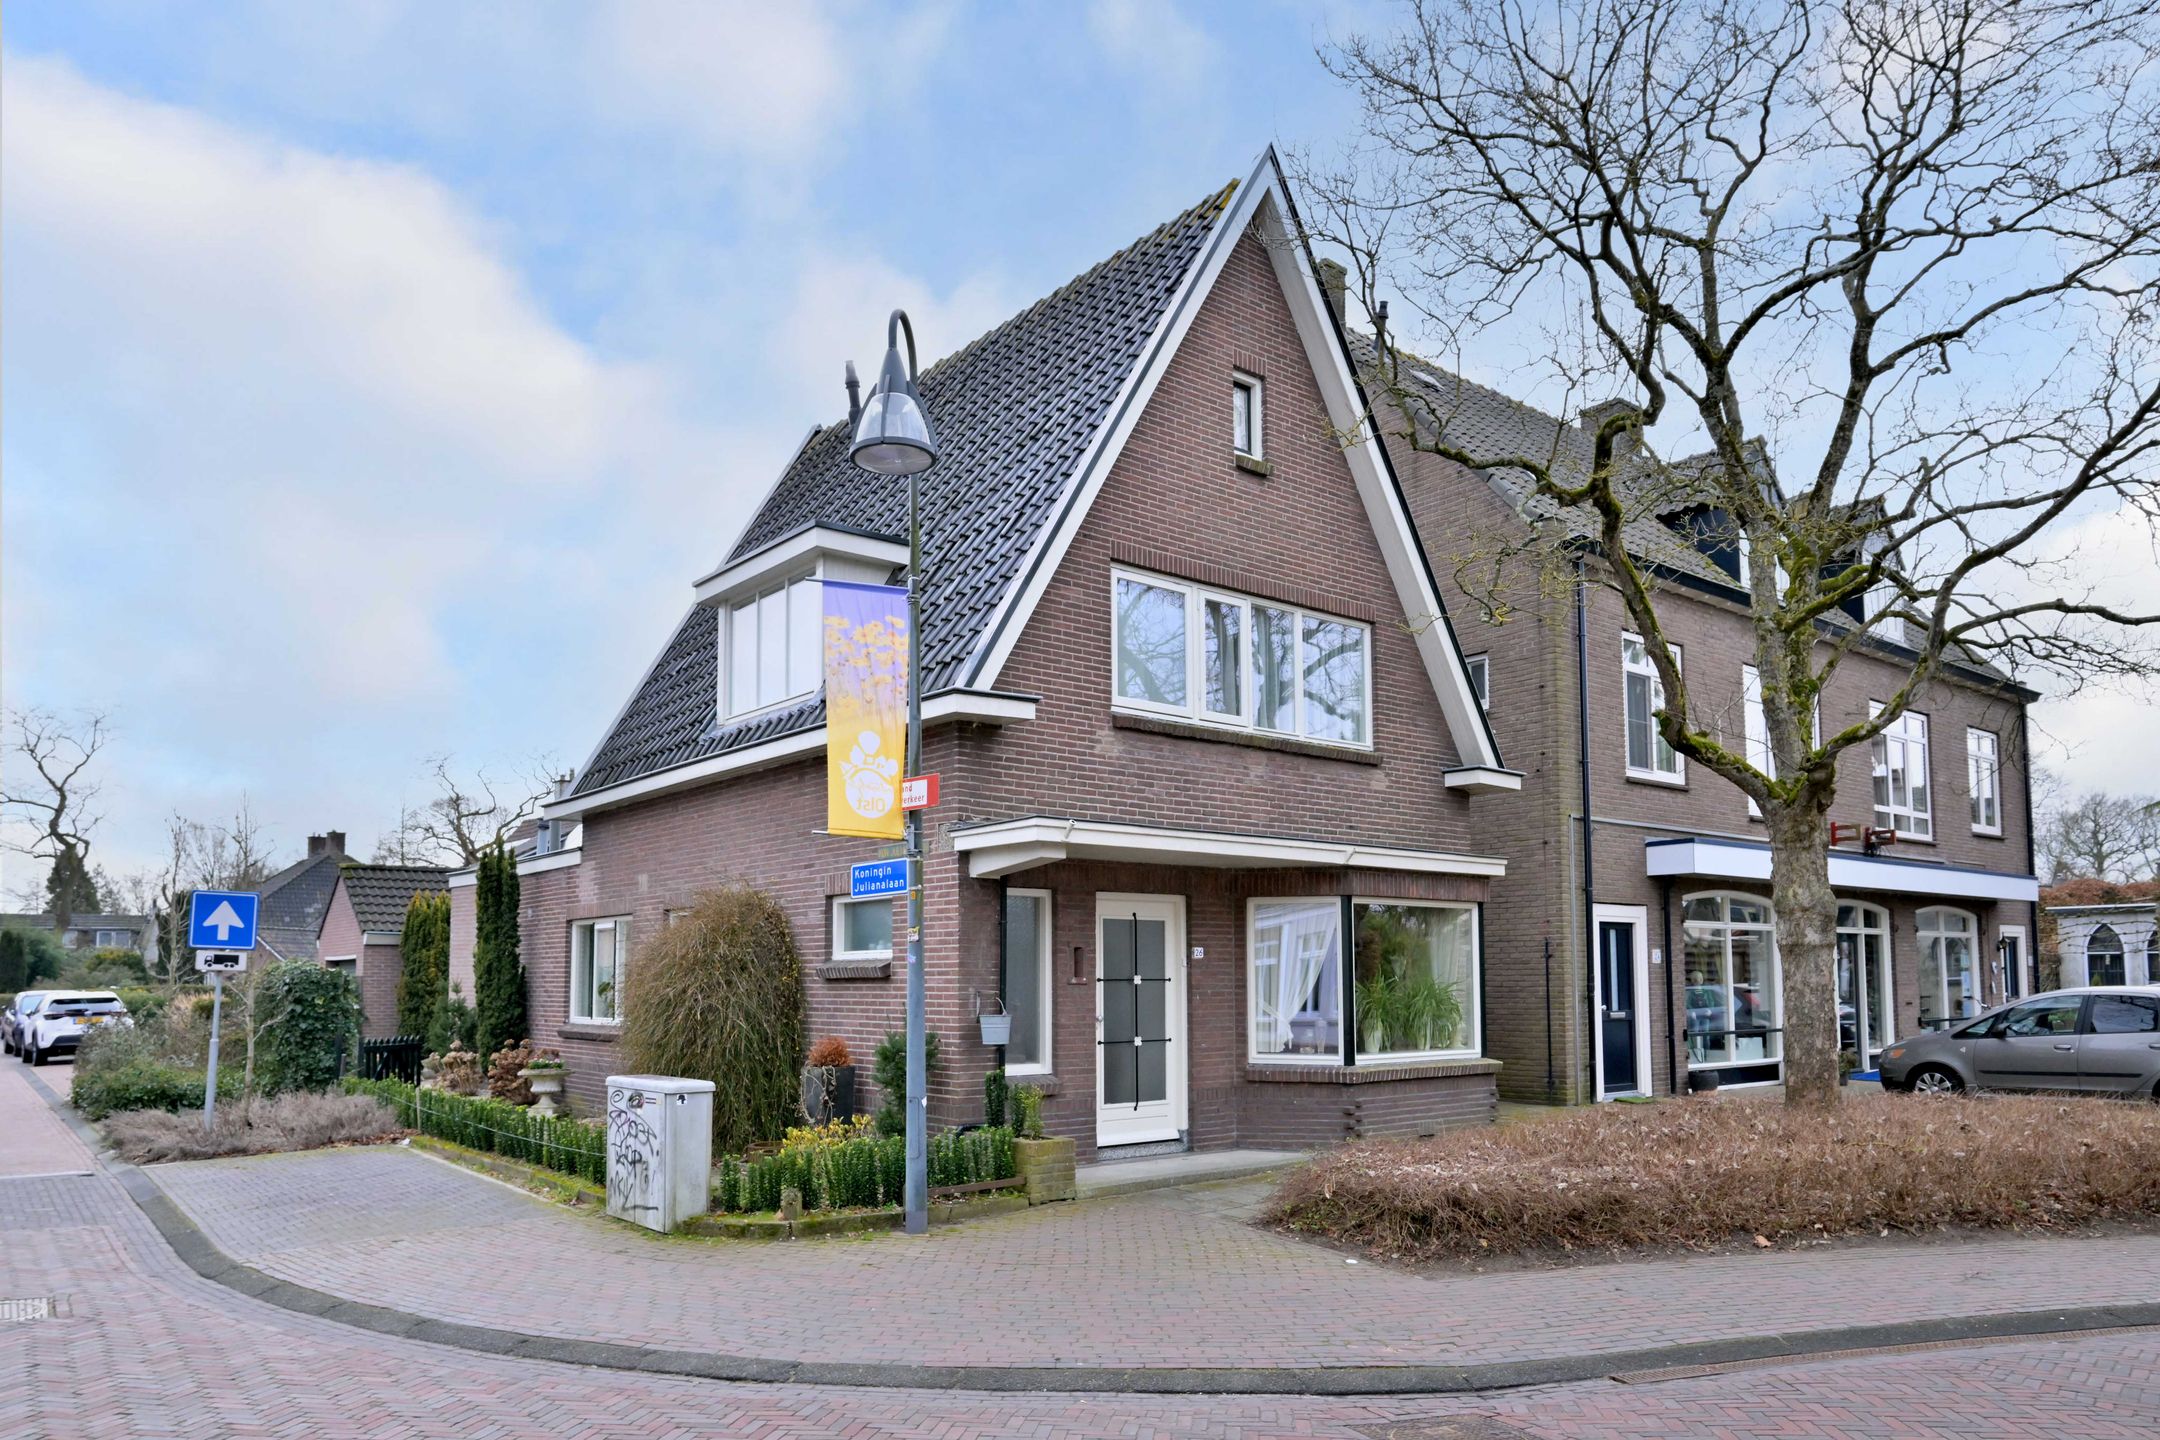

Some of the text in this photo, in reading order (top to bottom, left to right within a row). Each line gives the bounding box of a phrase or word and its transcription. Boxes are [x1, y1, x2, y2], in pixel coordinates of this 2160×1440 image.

[902, 795, 925, 804] erkeer
[854, 866, 892, 879] Koningin
[854, 879, 905, 893] Julianalaan
[1195, 948, 1203, 957] 26
